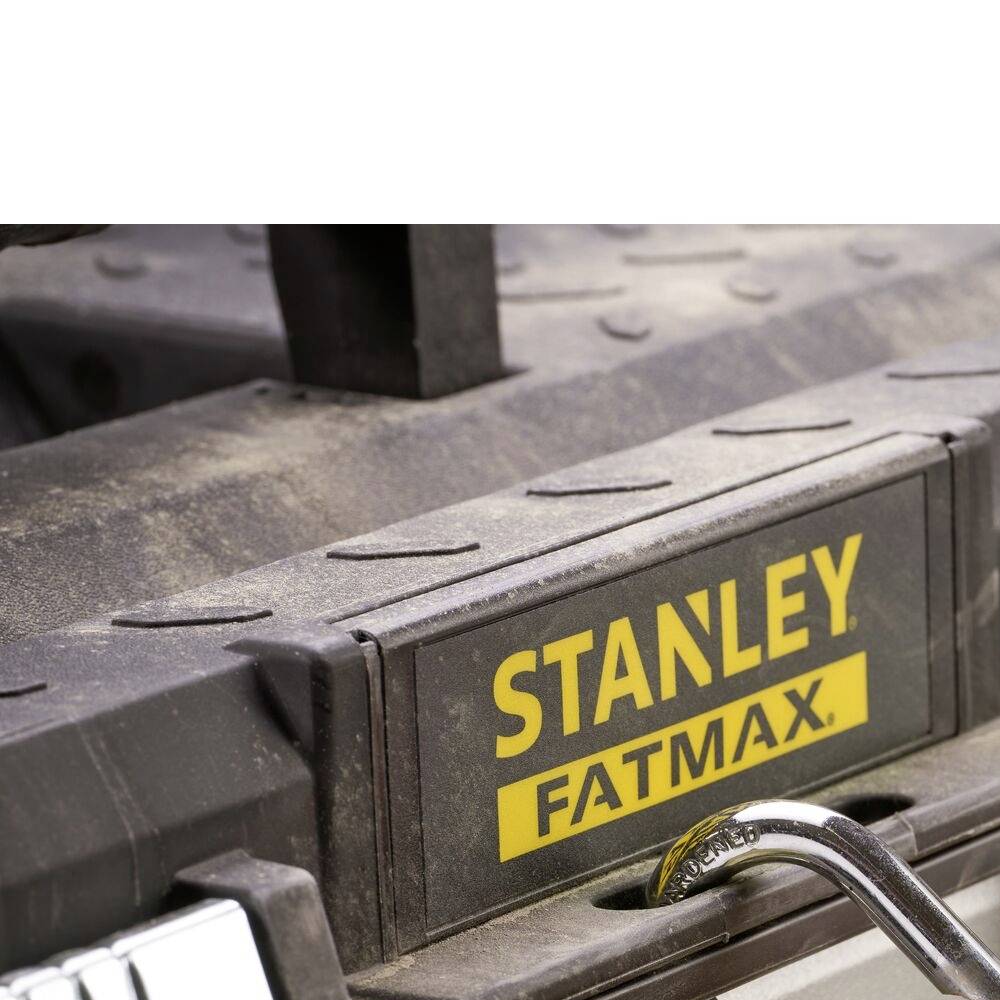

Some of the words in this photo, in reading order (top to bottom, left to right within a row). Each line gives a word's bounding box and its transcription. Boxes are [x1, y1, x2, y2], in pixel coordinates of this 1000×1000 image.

[493, 533, 863, 758] STANLEY
[536, 678, 826, 838] FATMAX
[663, 823, 761, 905] ARDENED
